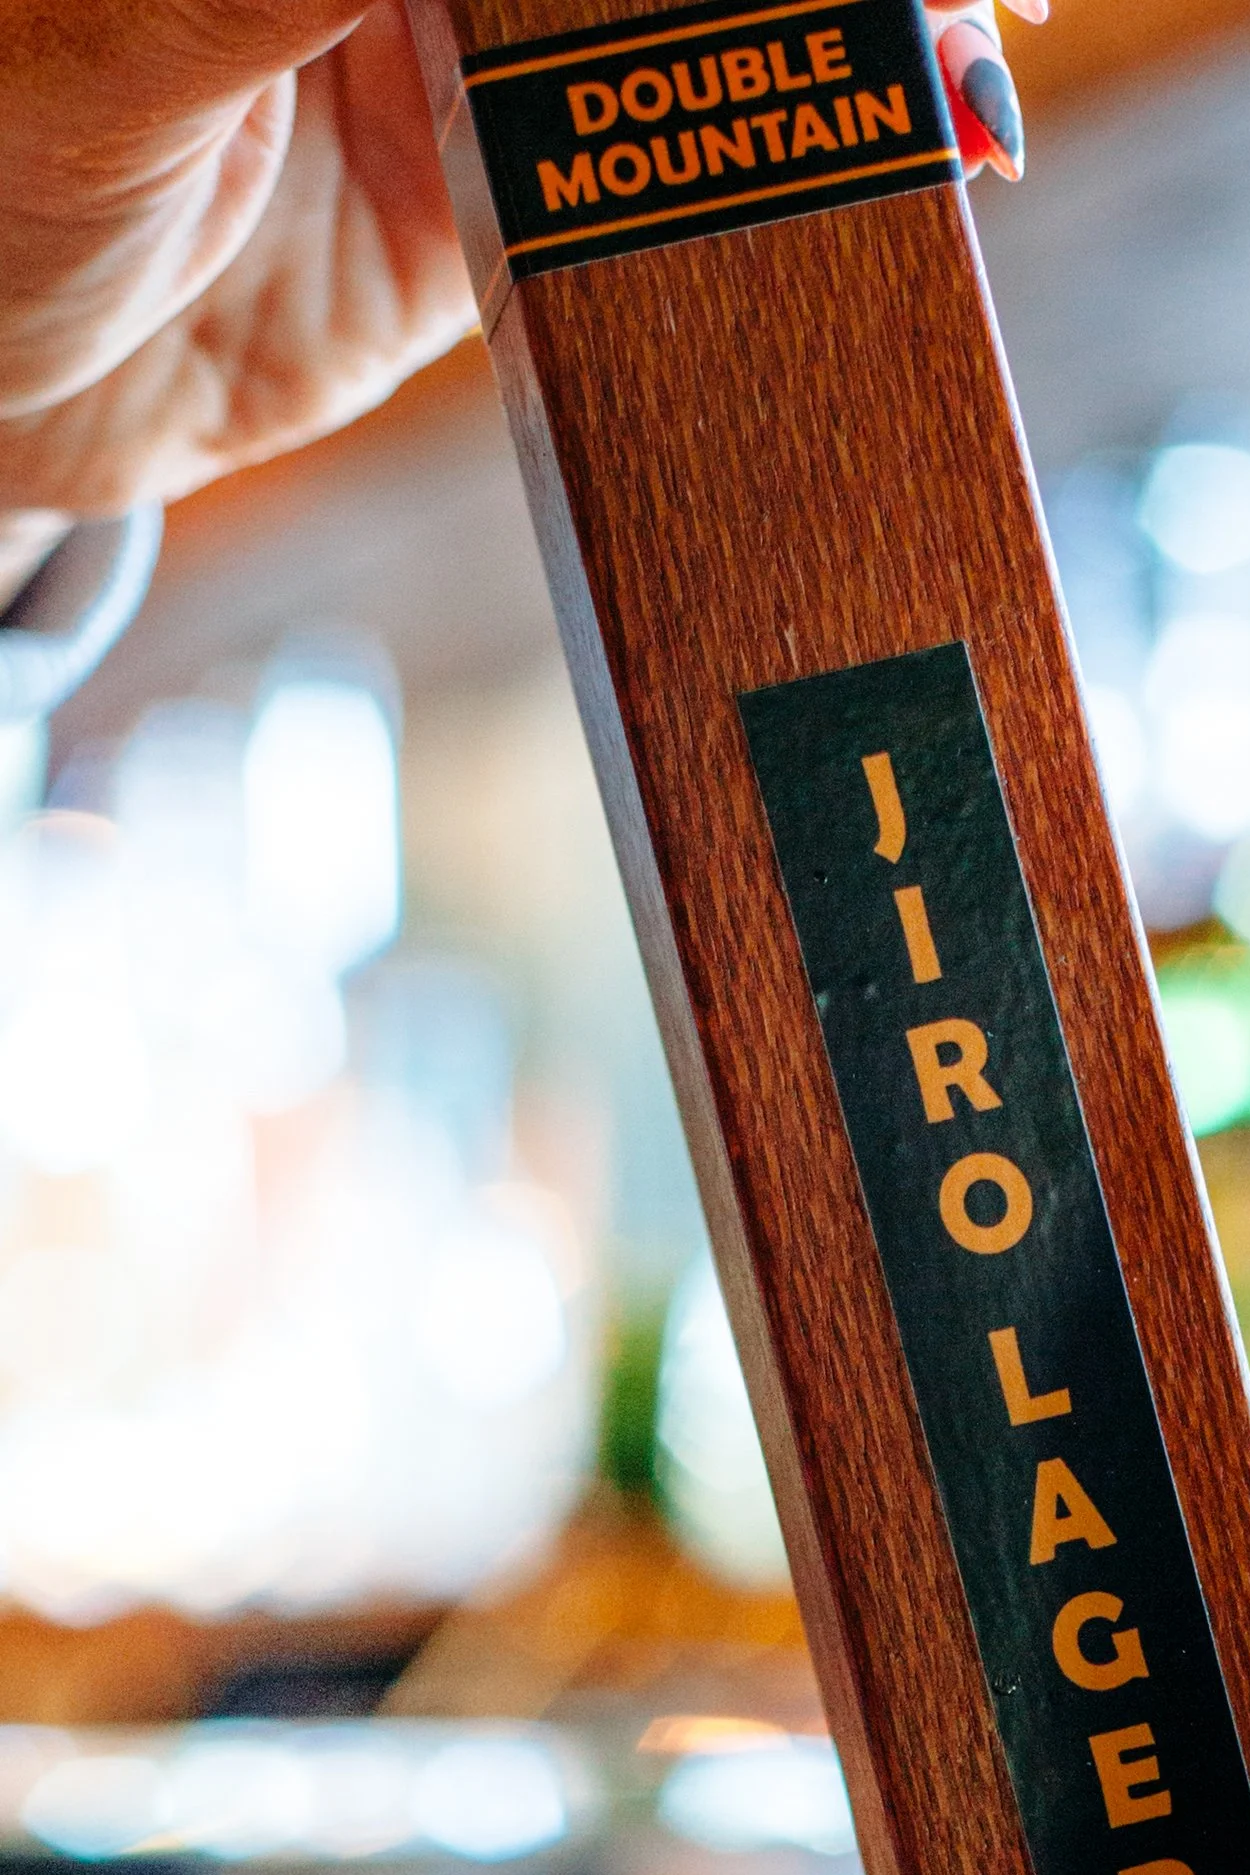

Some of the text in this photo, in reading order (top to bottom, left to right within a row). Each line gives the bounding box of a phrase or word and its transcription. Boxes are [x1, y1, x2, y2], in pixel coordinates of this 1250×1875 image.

[565, 28, 853, 136] DOUBLE
[536, 83, 913, 212] MOUNTAIN
[861, 751, 1034, 1255] JIRO
